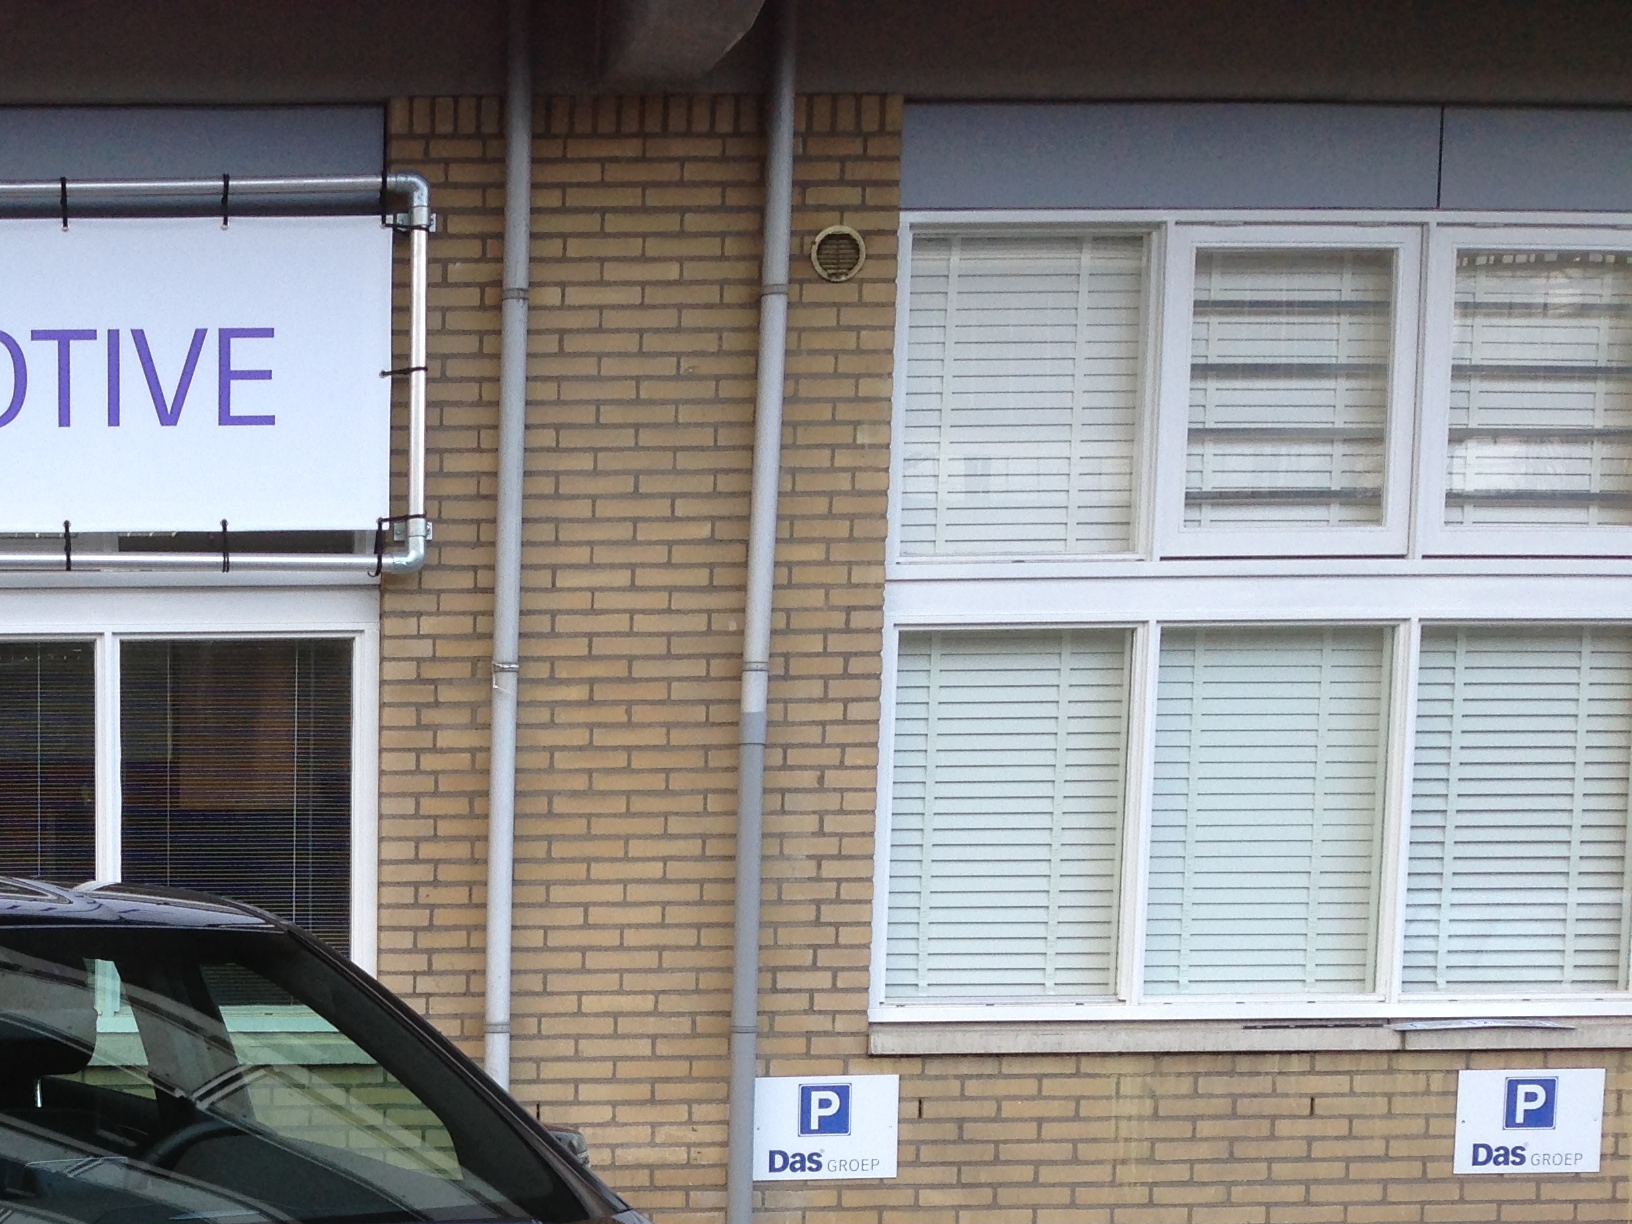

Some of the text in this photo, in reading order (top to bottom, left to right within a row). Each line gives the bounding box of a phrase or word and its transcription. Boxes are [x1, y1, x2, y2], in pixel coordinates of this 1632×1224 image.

[810, 1090, 841, 1130] P
[1515, 1084, 1547, 1124] P
[768, 1149, 880, 1173] Das GROEP
[1471, 1143, 1584, 1167] Das GROEP
